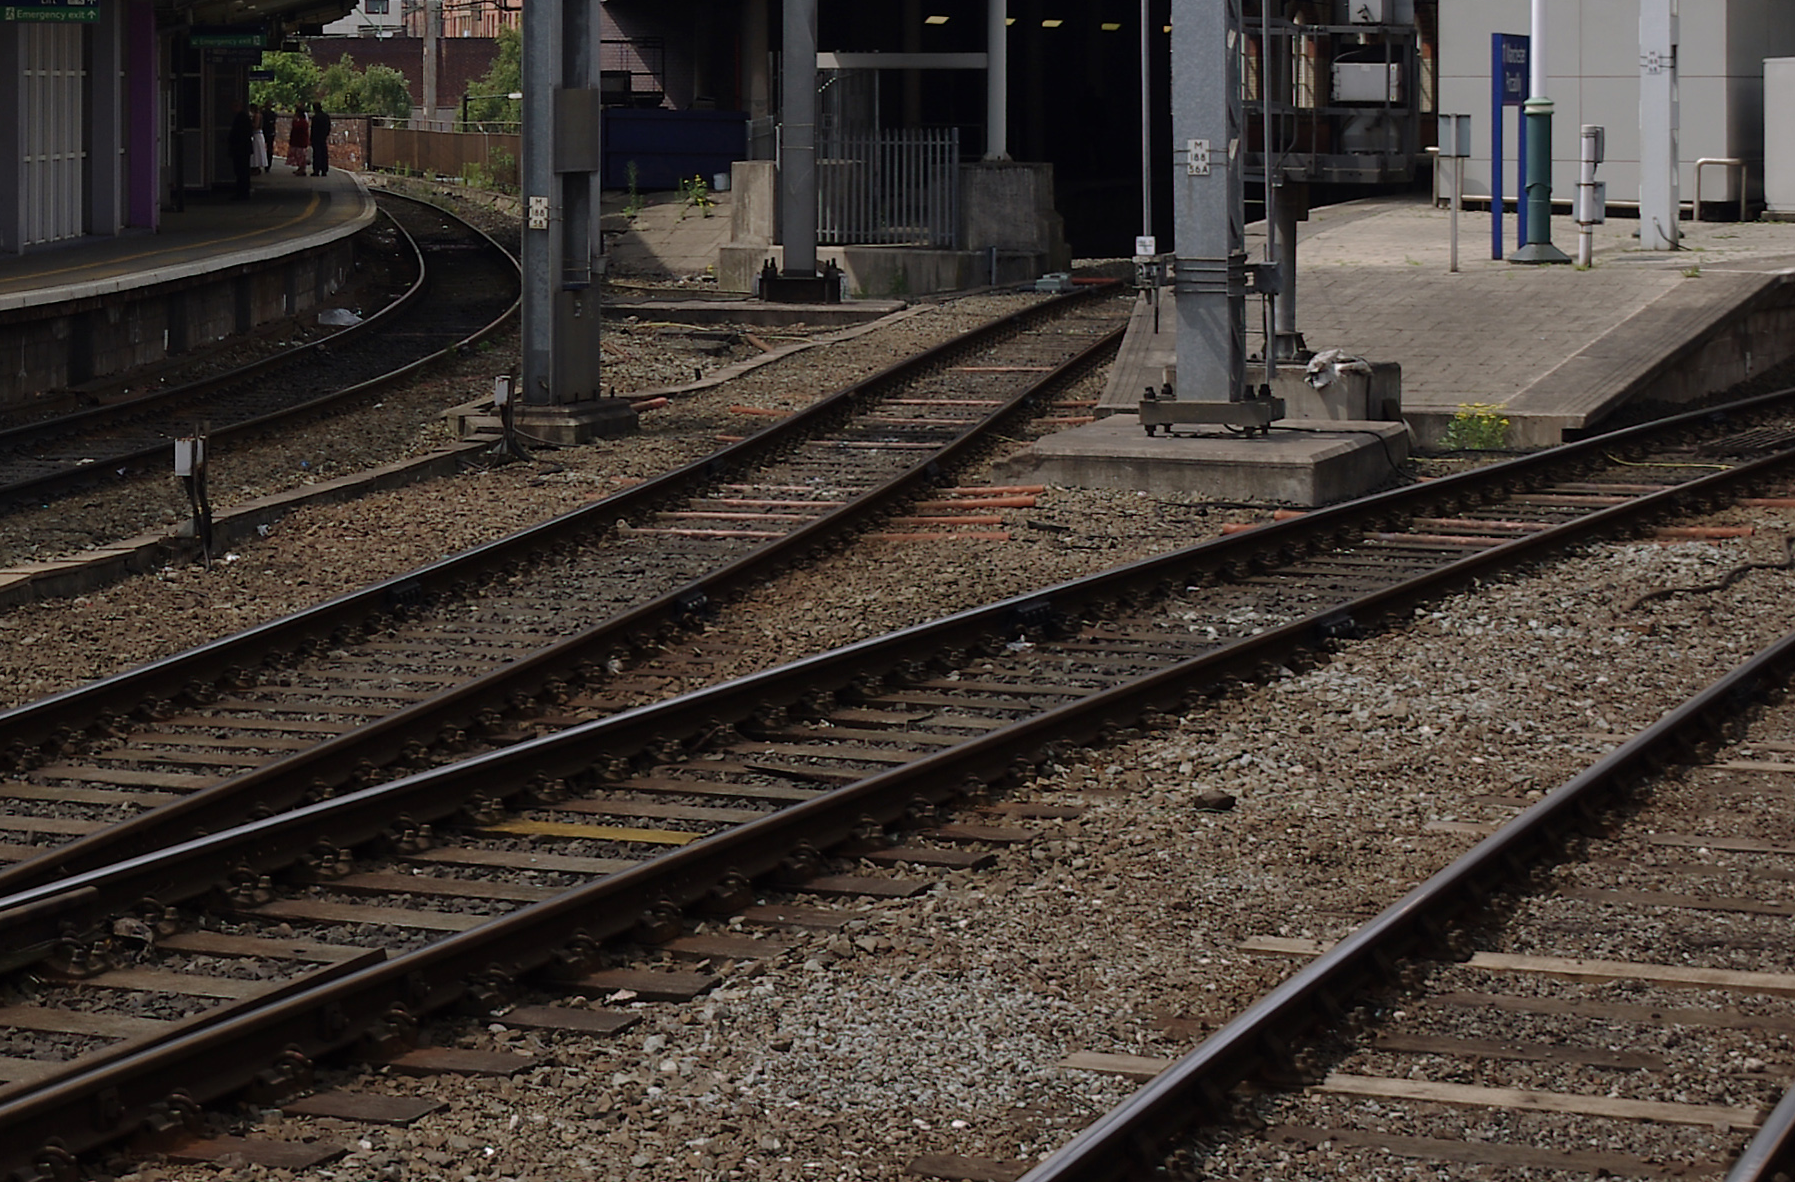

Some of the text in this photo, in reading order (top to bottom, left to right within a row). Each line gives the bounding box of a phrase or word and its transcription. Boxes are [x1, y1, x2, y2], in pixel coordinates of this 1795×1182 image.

[16, 9, 85, 20] Emergency exit
[1194, 140, 1203, 149] M
[1190, 152, 1206, 162] 188
[1189, 164, 1209, 174] 56A
[535, 198, 542, 206] M
